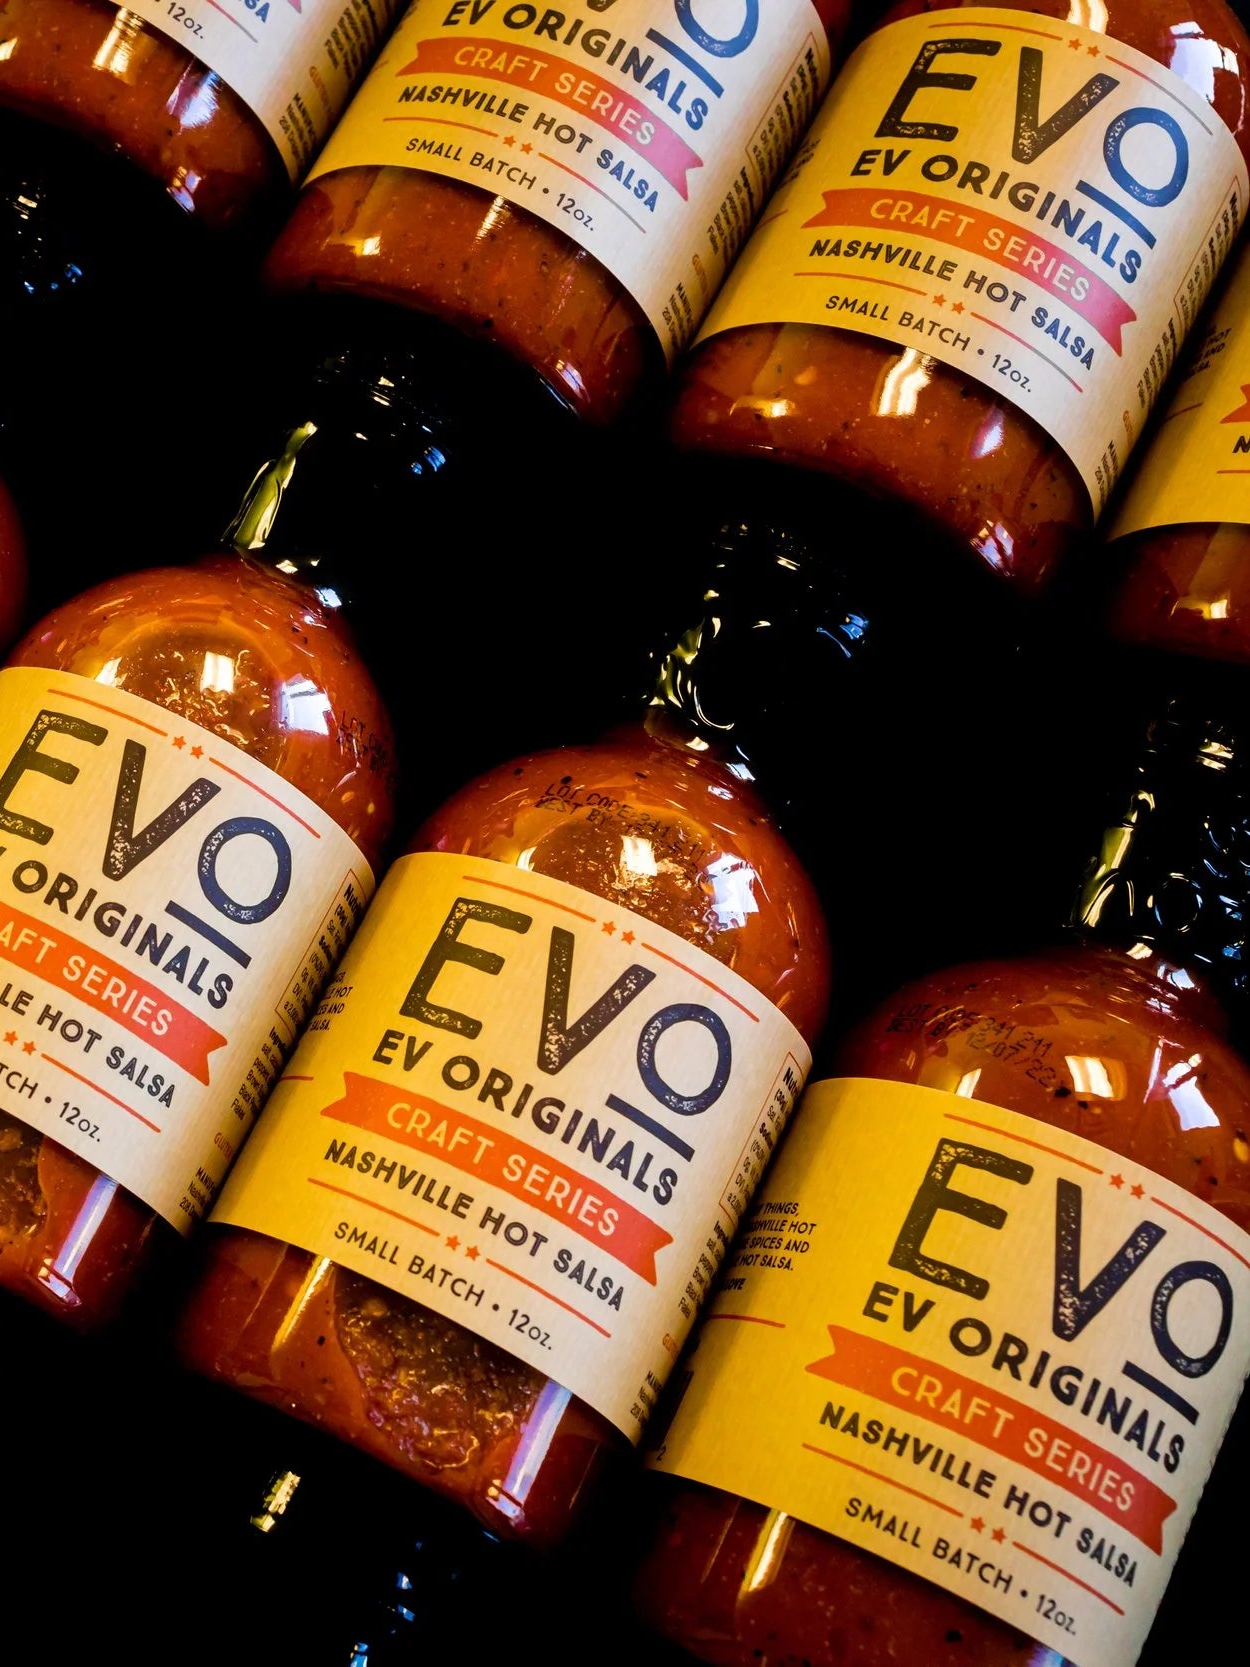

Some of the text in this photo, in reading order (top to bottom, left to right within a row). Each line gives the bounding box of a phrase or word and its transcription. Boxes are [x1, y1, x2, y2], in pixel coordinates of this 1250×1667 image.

[443, 0, 496, 27] EV
[502, 3, 709, 131] ORIGINALS
[454, 46, 657, 146] CRAFT SERIES
[874, 38, 1189, 207] EVO
[398, 86, 660, 213] NASHVILLE HOT SALSA
[406, 138, 461, 162] SMALL
[469, 151, 539, 192] BATCH
[850, 149, 912, 176] EV
[921, 154, 1143, 284] ORIGINALS
[869, 199, 1091, 301] CRAFT SERIES
[809, 239, 957, 281] NASHVILLE
[962, 270, 1027, 313] HOT
[1031, 306, 1094, 371] SALSA
[825, 295, 890, 321] SMALL
[898, 313, 971, 355] BATCH
[12, 859, 235, 1010] ORIGINALS
[62, 955, 173, 1037] SERIES
[37, 1004, 102, 1053] HOT
[105, 1046, 177, 1109] SALSA
[399, 897, 733, 1117] EVO
[372, 1029, 434, 1072] EV
[441, 1055, 679, 1206] ORIGINALS
[386, 1103, 620, 1238] CRAFT SERIES
[324, 1140, 475, 1221] NASHVILLE
[478, 1207, 549, 1257] HOT
[553, 1249, 624, 1311] SALSA
[334, 1222, 400, 1268] SMALL
[407, 1255, 486, 1309] BATCH
[739, 1254, 793, 1271] HOT SALSA.
[750, 1237, 809, 1253] SPICES AND
[764, 1202, 799, 1217] THINGS,
[788, 1221, 816, 1235] HOT
[888, 1137, 1234, 1380] EVO
[862, 1281, 1185, 1473] EV ORIGINALS
[891, 1367, 1136, 1512] CRAFT SERIES
[819, 1401, 1138, 1588] NASHVILLE HOT SALSA
[845, 1497, 922, 1550] SMALL
[931, 1536, 1013, 1595] BATCH
